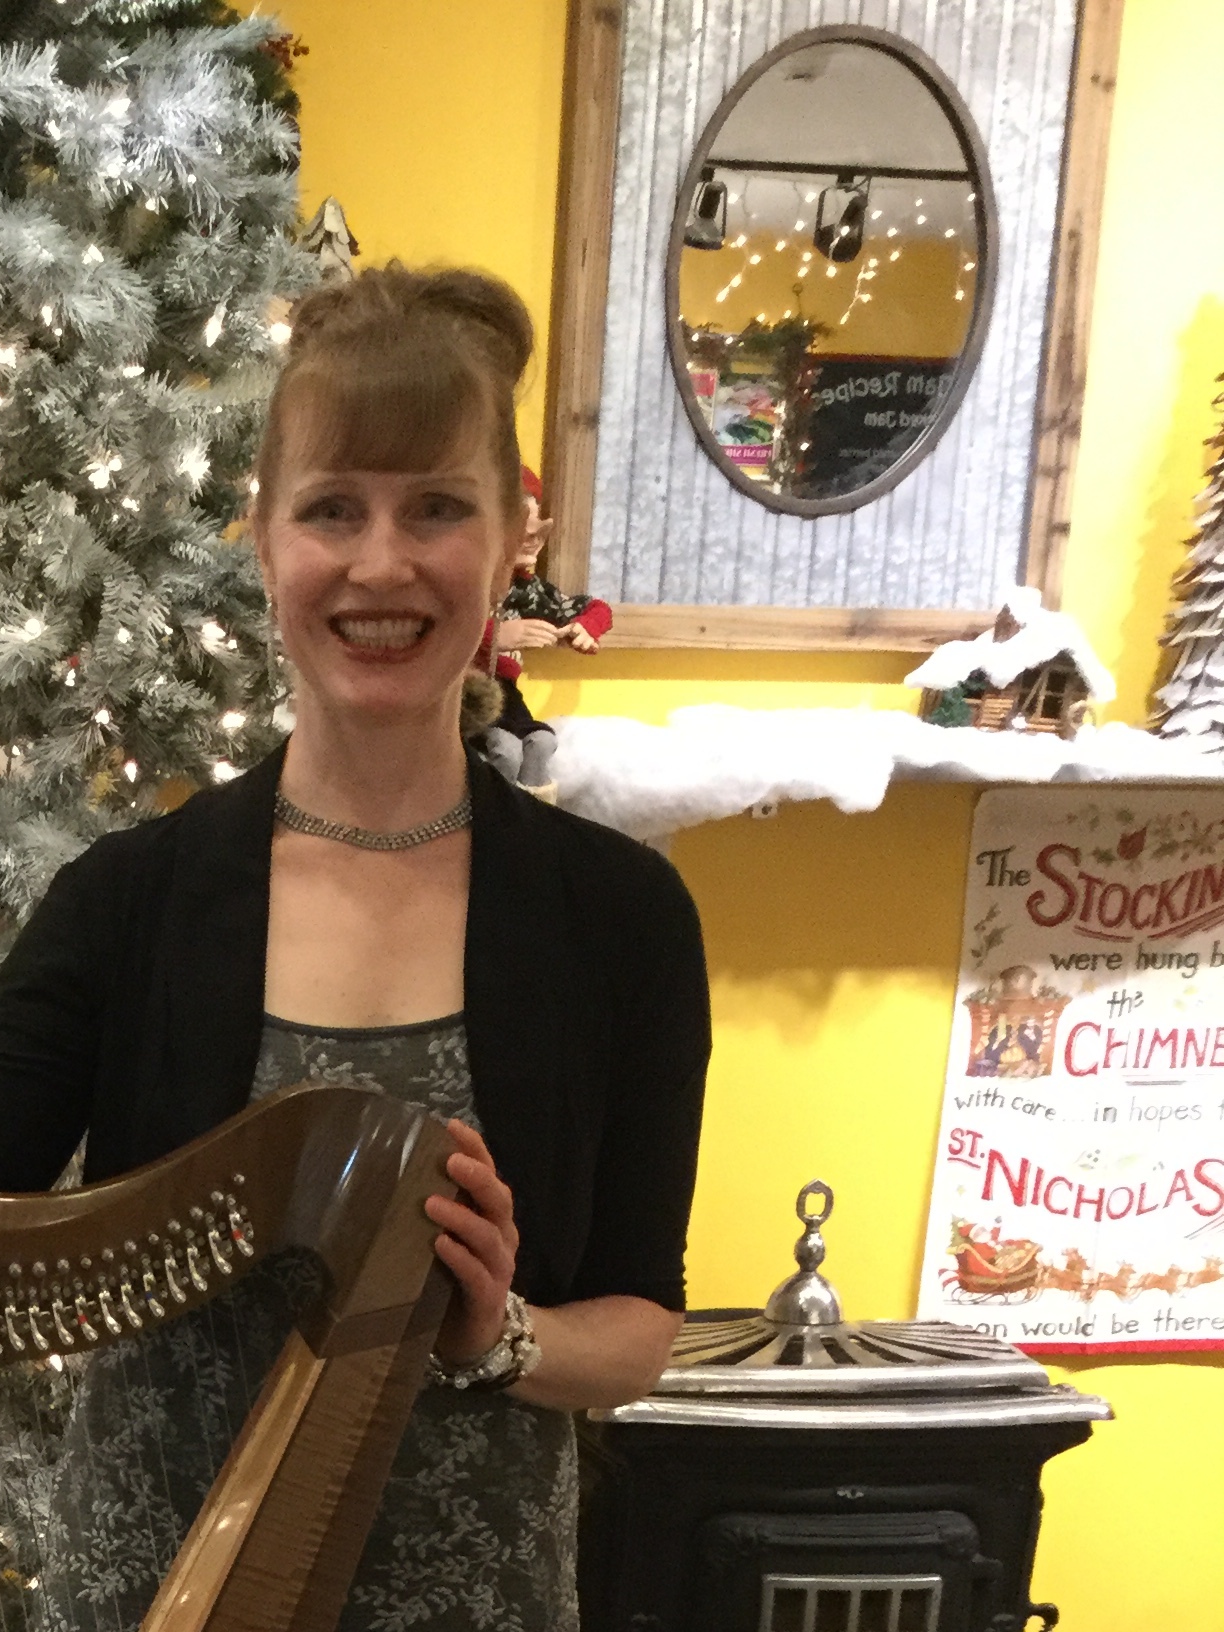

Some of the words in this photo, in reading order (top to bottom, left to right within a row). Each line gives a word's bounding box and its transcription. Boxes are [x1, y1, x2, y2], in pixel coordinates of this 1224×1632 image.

[976, 845, 1032, 887] The
[1049, 951, 1123, 972] were
[1136, 941, 1201, 979] hung
[1107, 989, 1144, 1019] the
[1064, 1021, 1224, 1077] CHIMNE
[954, 1087, 1005, 1111] with
[1093, 1102, 1118, 1123] in
[1129, 1096, 1203, 1132] hopes
[981, 1148, 1224, 1222] NICHOLAS
[964, 1322, 1008, 1338] on
[1021, 1313, 1097, 1338] would
[1111, 1312, 1141, 1335] be
[1153, 1306, 1224, 1334] there
